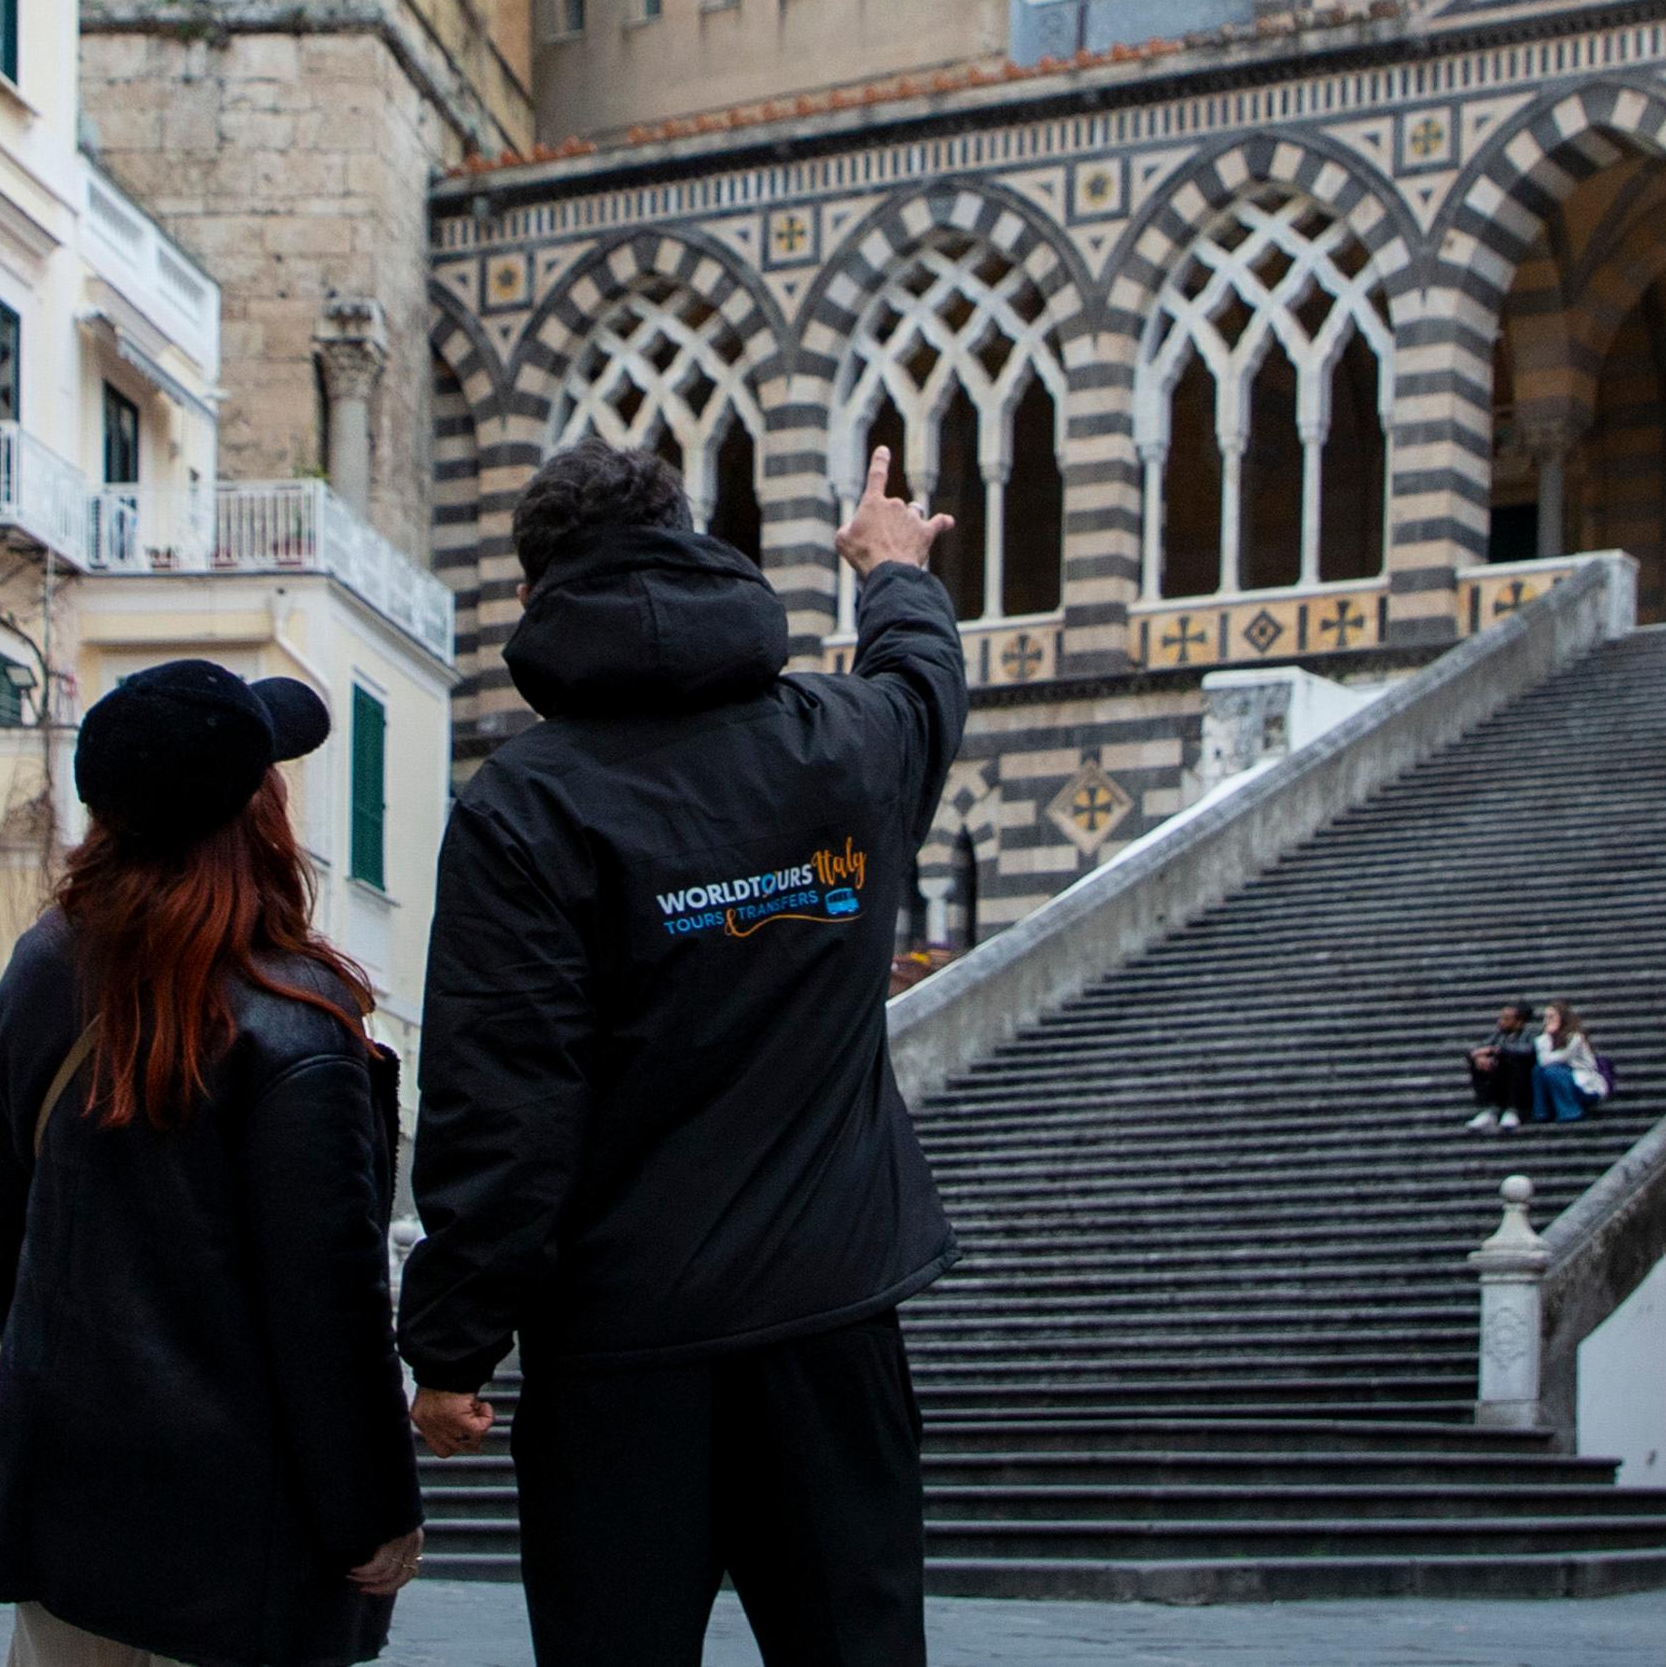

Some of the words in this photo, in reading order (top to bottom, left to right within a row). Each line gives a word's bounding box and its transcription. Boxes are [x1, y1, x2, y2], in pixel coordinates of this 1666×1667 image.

[656, 863, 813, 915] WORLDTOURS
[811, 836, 868, 890] Italy
[664, 910, 725, 935] TOURS
[737, 890, 819, 921] TRANSFERS
